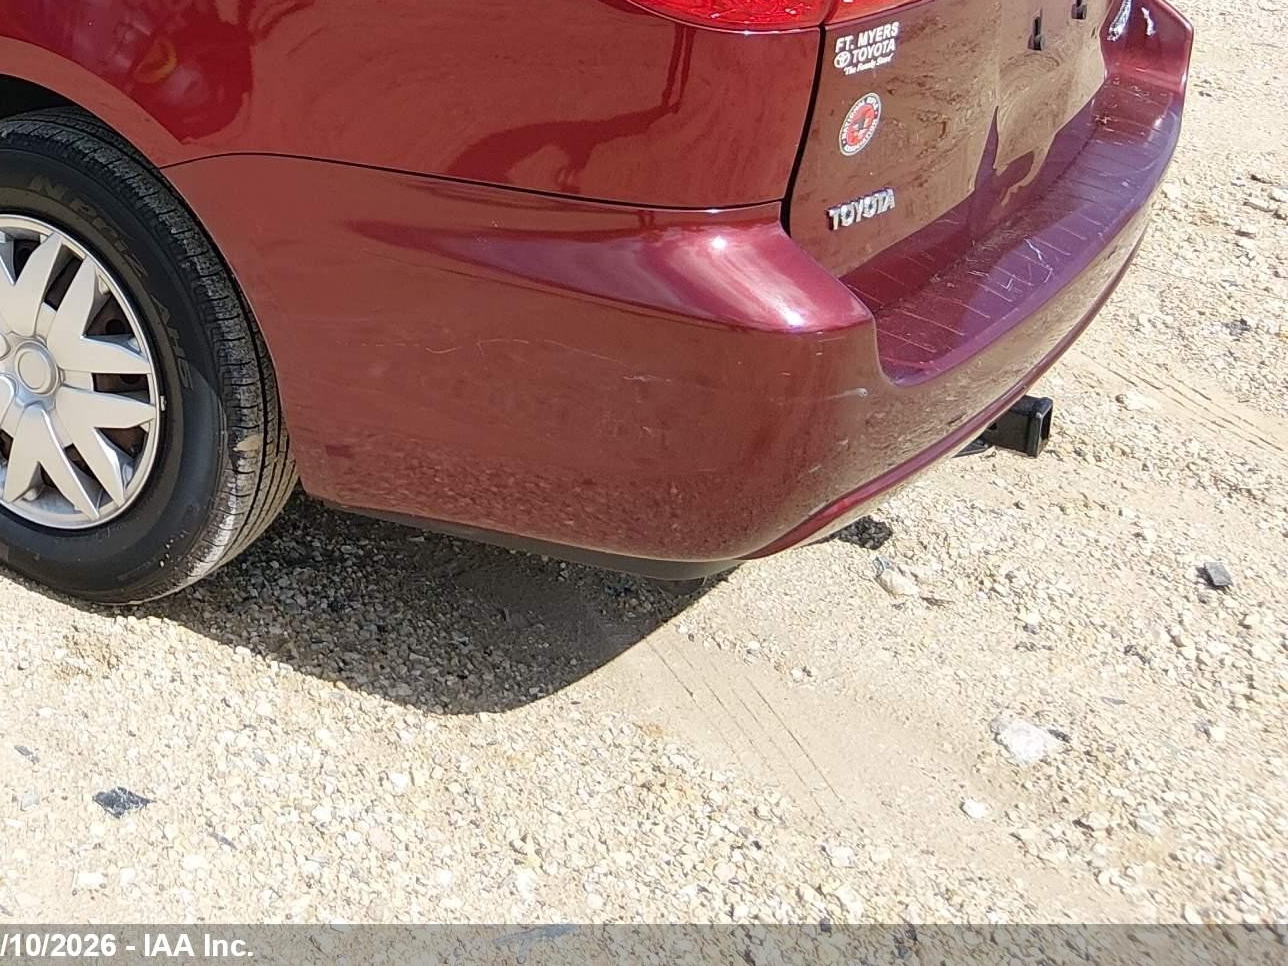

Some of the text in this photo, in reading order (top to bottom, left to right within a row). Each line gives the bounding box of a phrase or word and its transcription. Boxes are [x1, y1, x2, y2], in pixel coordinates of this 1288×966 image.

[835, 22, 899, 53] FT. MYERS
[852, 38, 896, 63] TOYOTA
[826, 188, 896, 231] TOYOTA
